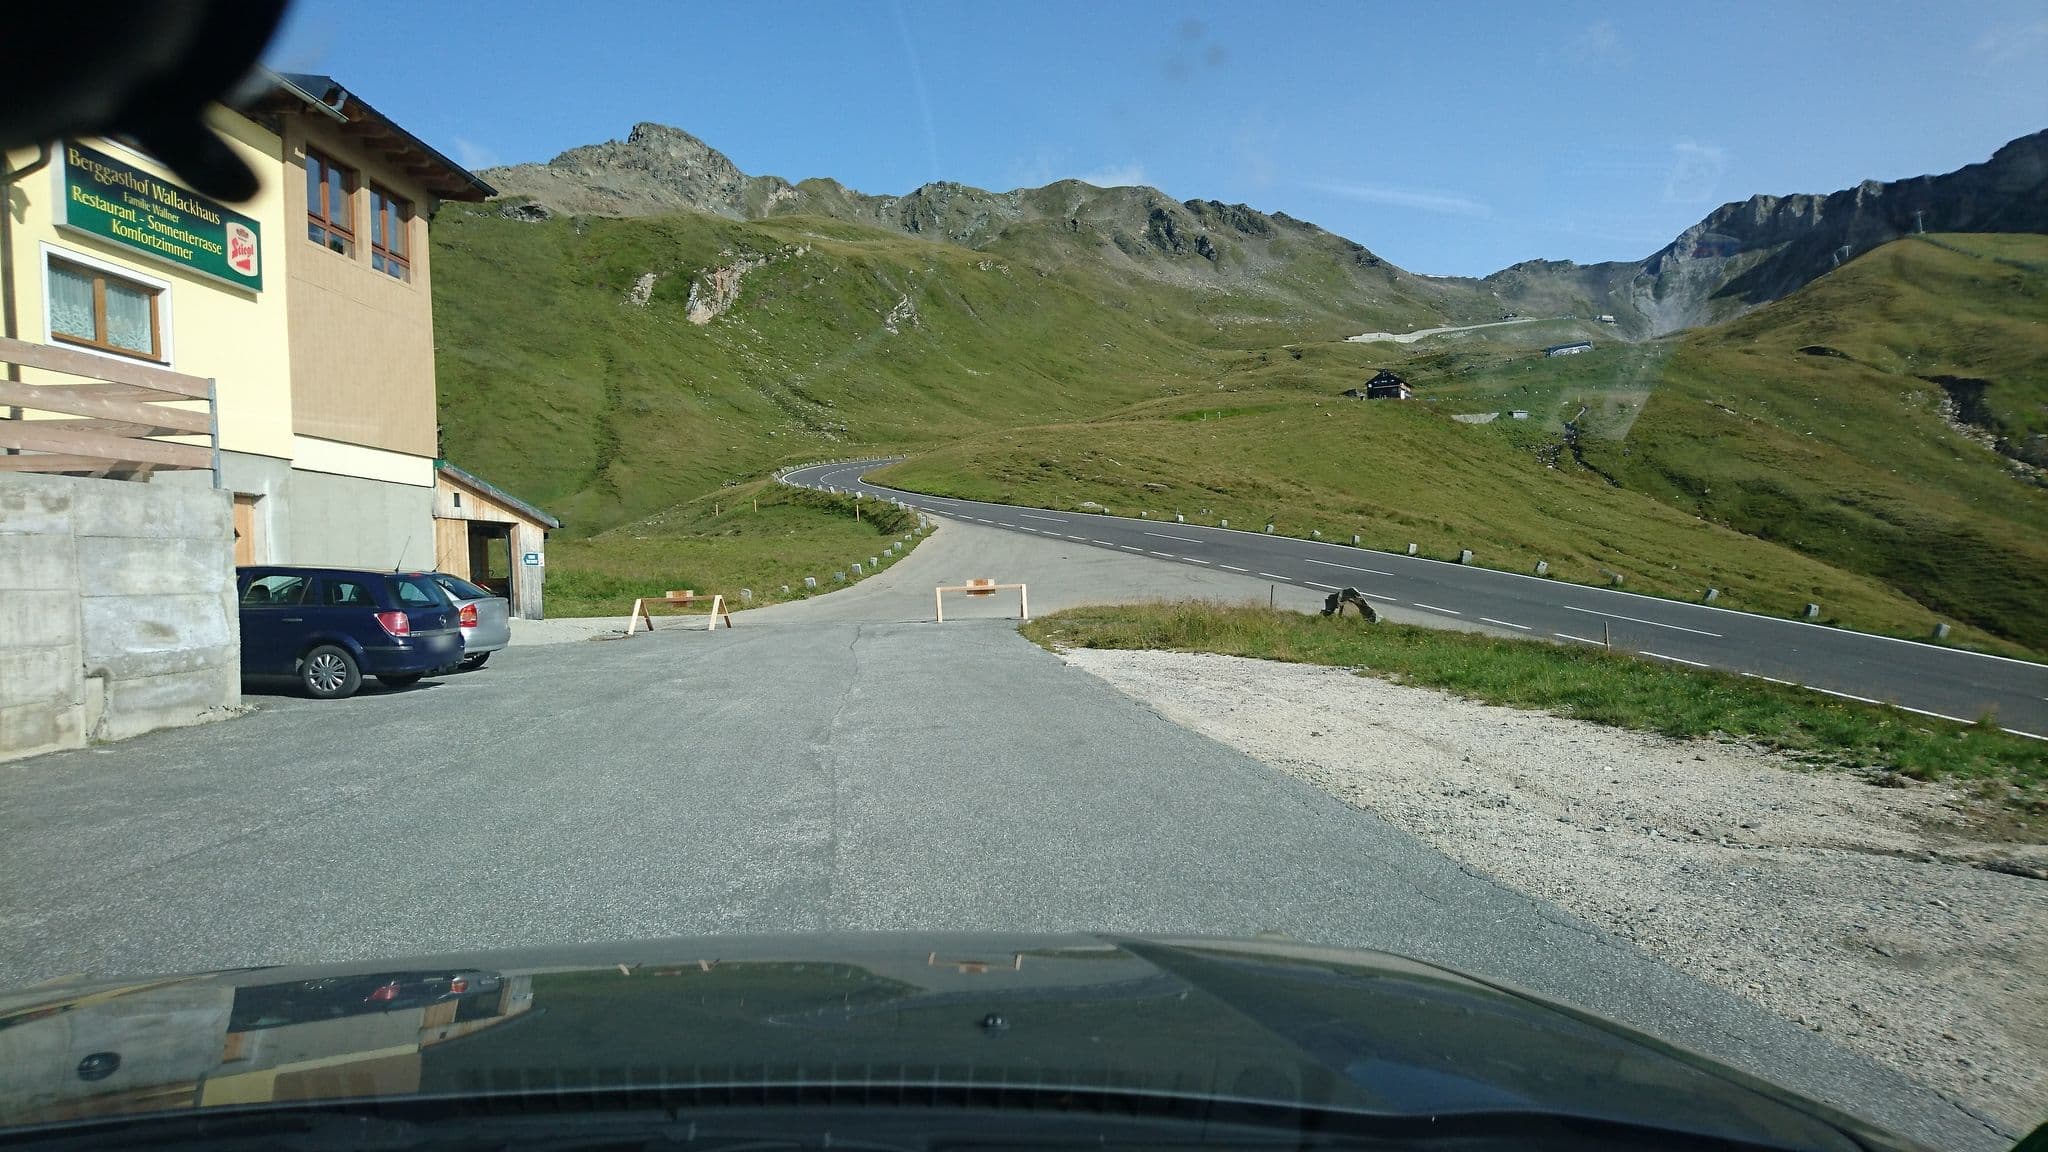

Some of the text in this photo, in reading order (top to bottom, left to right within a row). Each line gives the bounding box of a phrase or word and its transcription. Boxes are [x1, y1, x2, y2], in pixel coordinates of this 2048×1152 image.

[69, 148, 221, 225] Berggasthof Wallackhaus
[72, 185, 136, 222] Restaurant
[148, 215, 222, 255] Sonnenterrasse
[112, 219, 194, 260] Komfortzimmer
[231, 237, 254, 259] Stiegl
